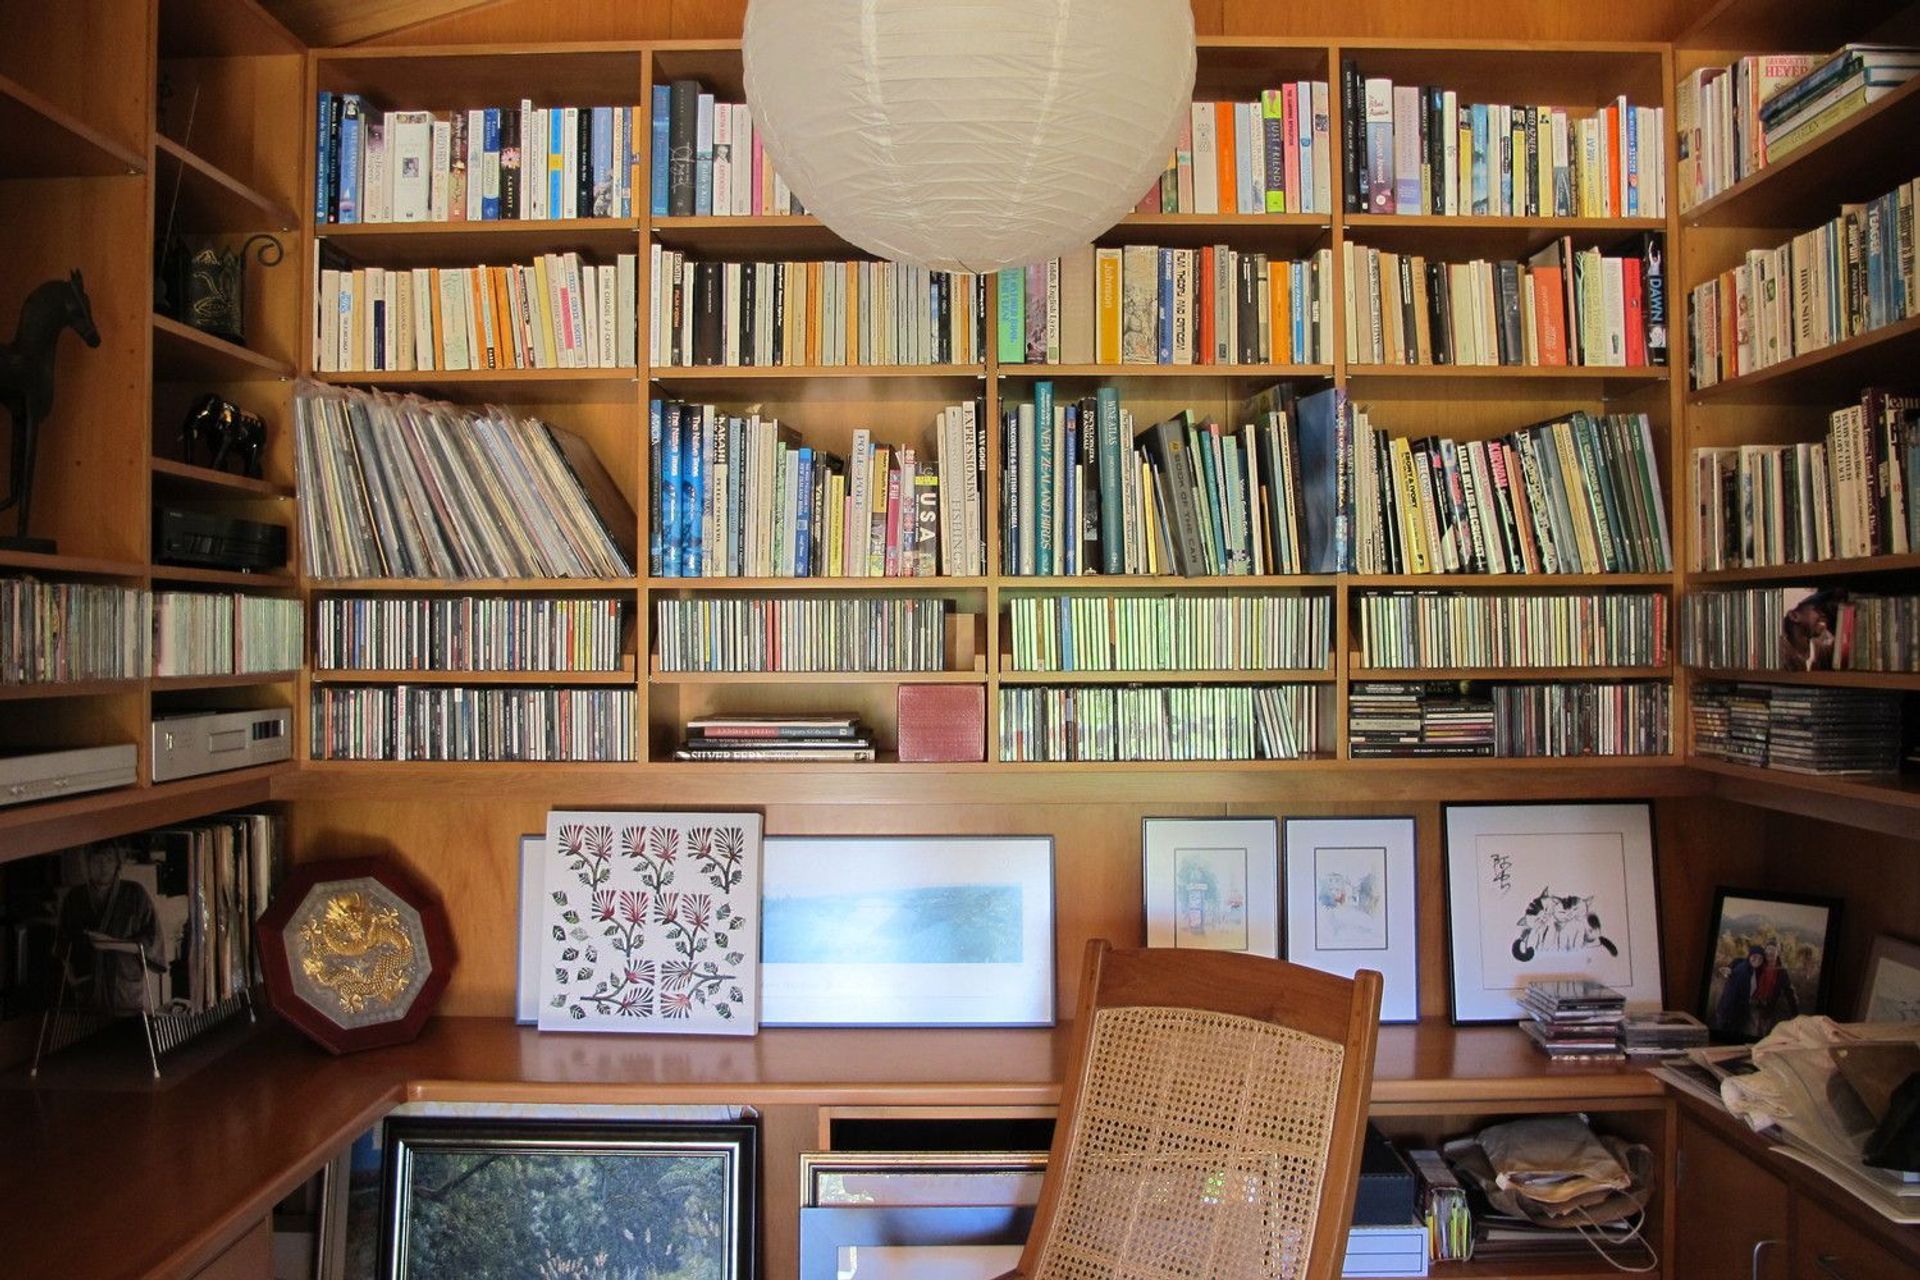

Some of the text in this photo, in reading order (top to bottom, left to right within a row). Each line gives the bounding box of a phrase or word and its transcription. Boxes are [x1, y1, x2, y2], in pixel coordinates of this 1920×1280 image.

[1272, 122, 1282, 187] JUST FRIENDS
[1176, 252, 1186, 268] FILM
[1048, 285, 1058, 312] English
[1104, 264, 1115, 309] Johnson
[1650, 278, 1662, 321] DAWN
[692, 416, 701, 434] The
[718, 416, 726, 463] KAKAHI
[1107, 400, 1116, 446] WINE ATLAS
[964, 410, 976, 502] EXPRESSIONISM
[1488, 442, 1508, 488] KIRWAN
[890, 484, 899, 500] Fiji
[1010, 494, 1018, 529] COLUMBIA
[1040, 427, 1051, 550] NEW ZEALAND BIRDS
[1174, 454, 1198, 564] BOOK OF THE CAR
[1584, 444, 1599, 492] CATALOGUE
[1600, 520, 1614, 558] UNIVERSE
[920, 492, 937, 542] USA
[1472, 518, 1485, 558] CRICKET
